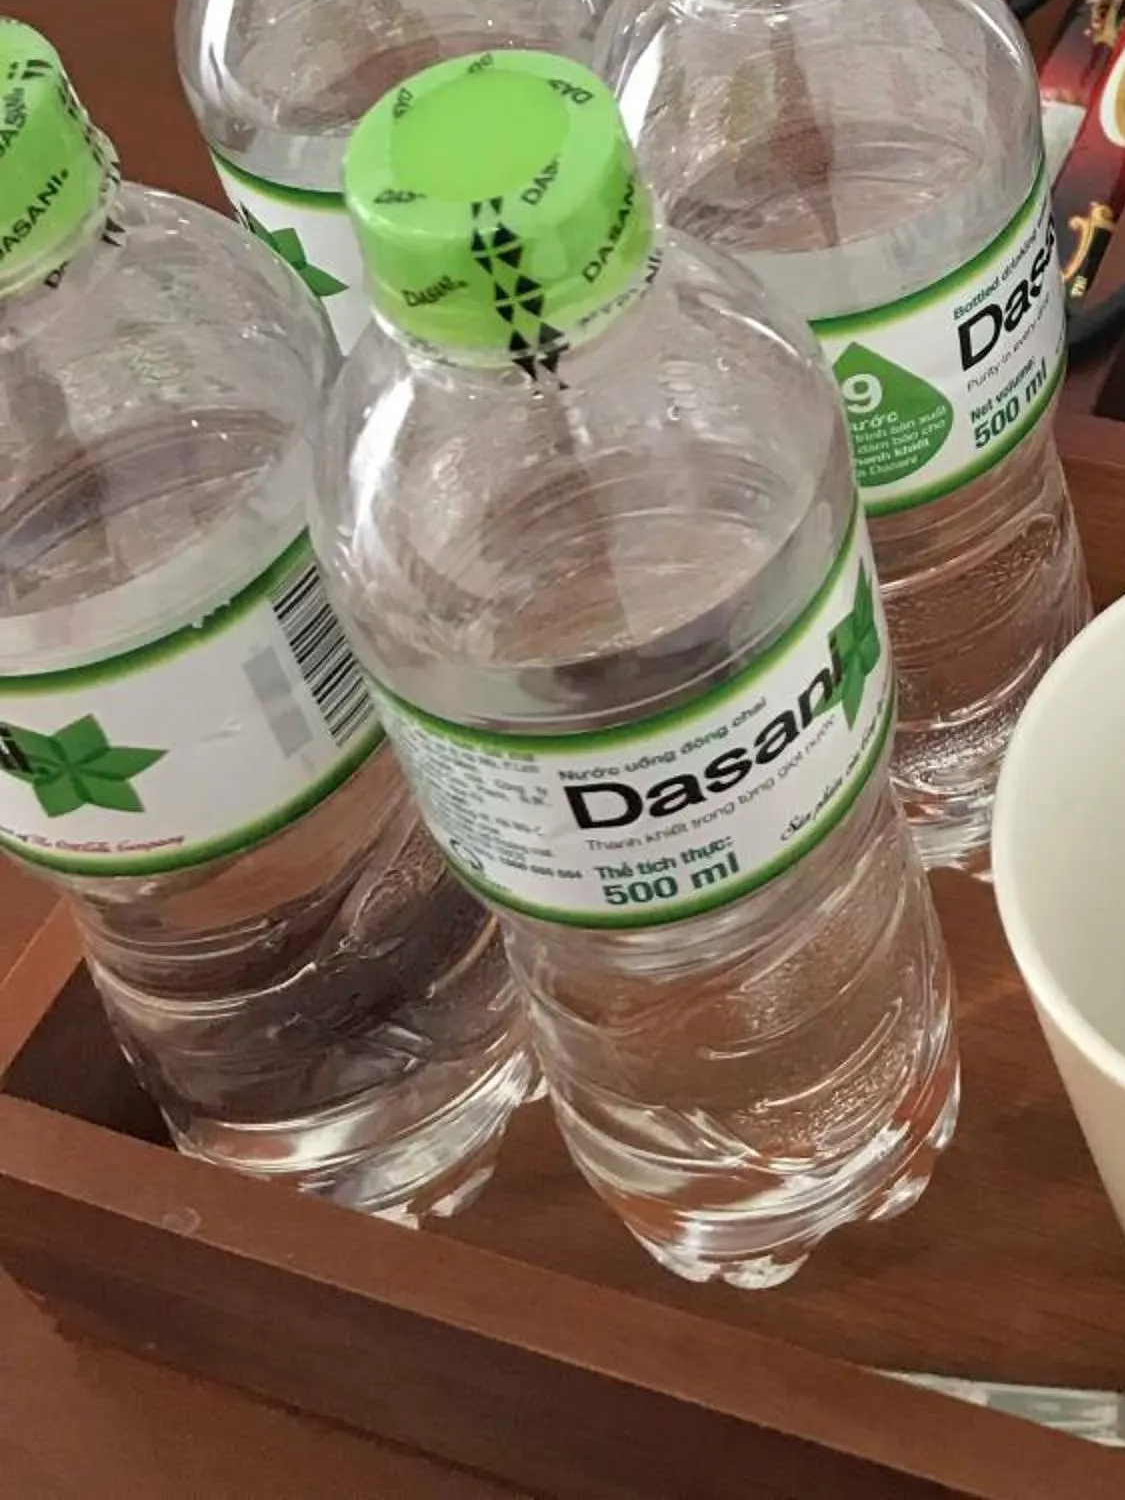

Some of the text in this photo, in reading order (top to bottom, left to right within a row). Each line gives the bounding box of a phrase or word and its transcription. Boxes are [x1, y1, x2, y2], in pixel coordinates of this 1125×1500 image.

[0, 169, 69, 262] ASANI
[971, 398, 993, 424] Net
[974, 357, 1048, 449] 500 ml
[564, 634, 843, 829] Dasani
[603, 852, 740, 906] 500 ml
[636, 857, 677, 876] tích
